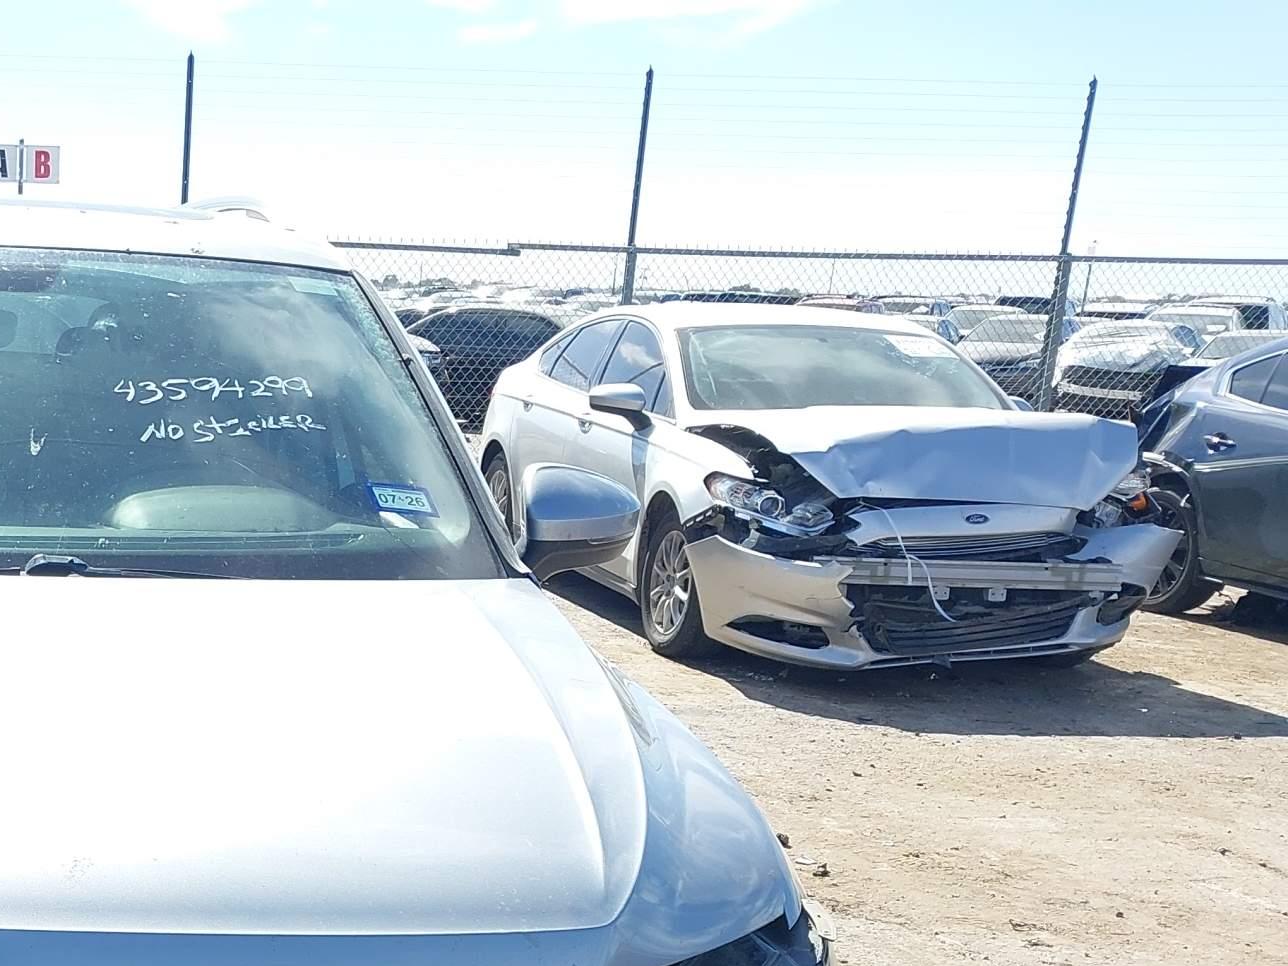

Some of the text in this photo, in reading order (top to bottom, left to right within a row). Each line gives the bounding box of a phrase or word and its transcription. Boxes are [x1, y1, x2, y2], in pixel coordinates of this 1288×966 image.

[34, 150, 51, 178] B
[113, 375, 313, 405] 43594299
[139, 419, 184, 443] NO
